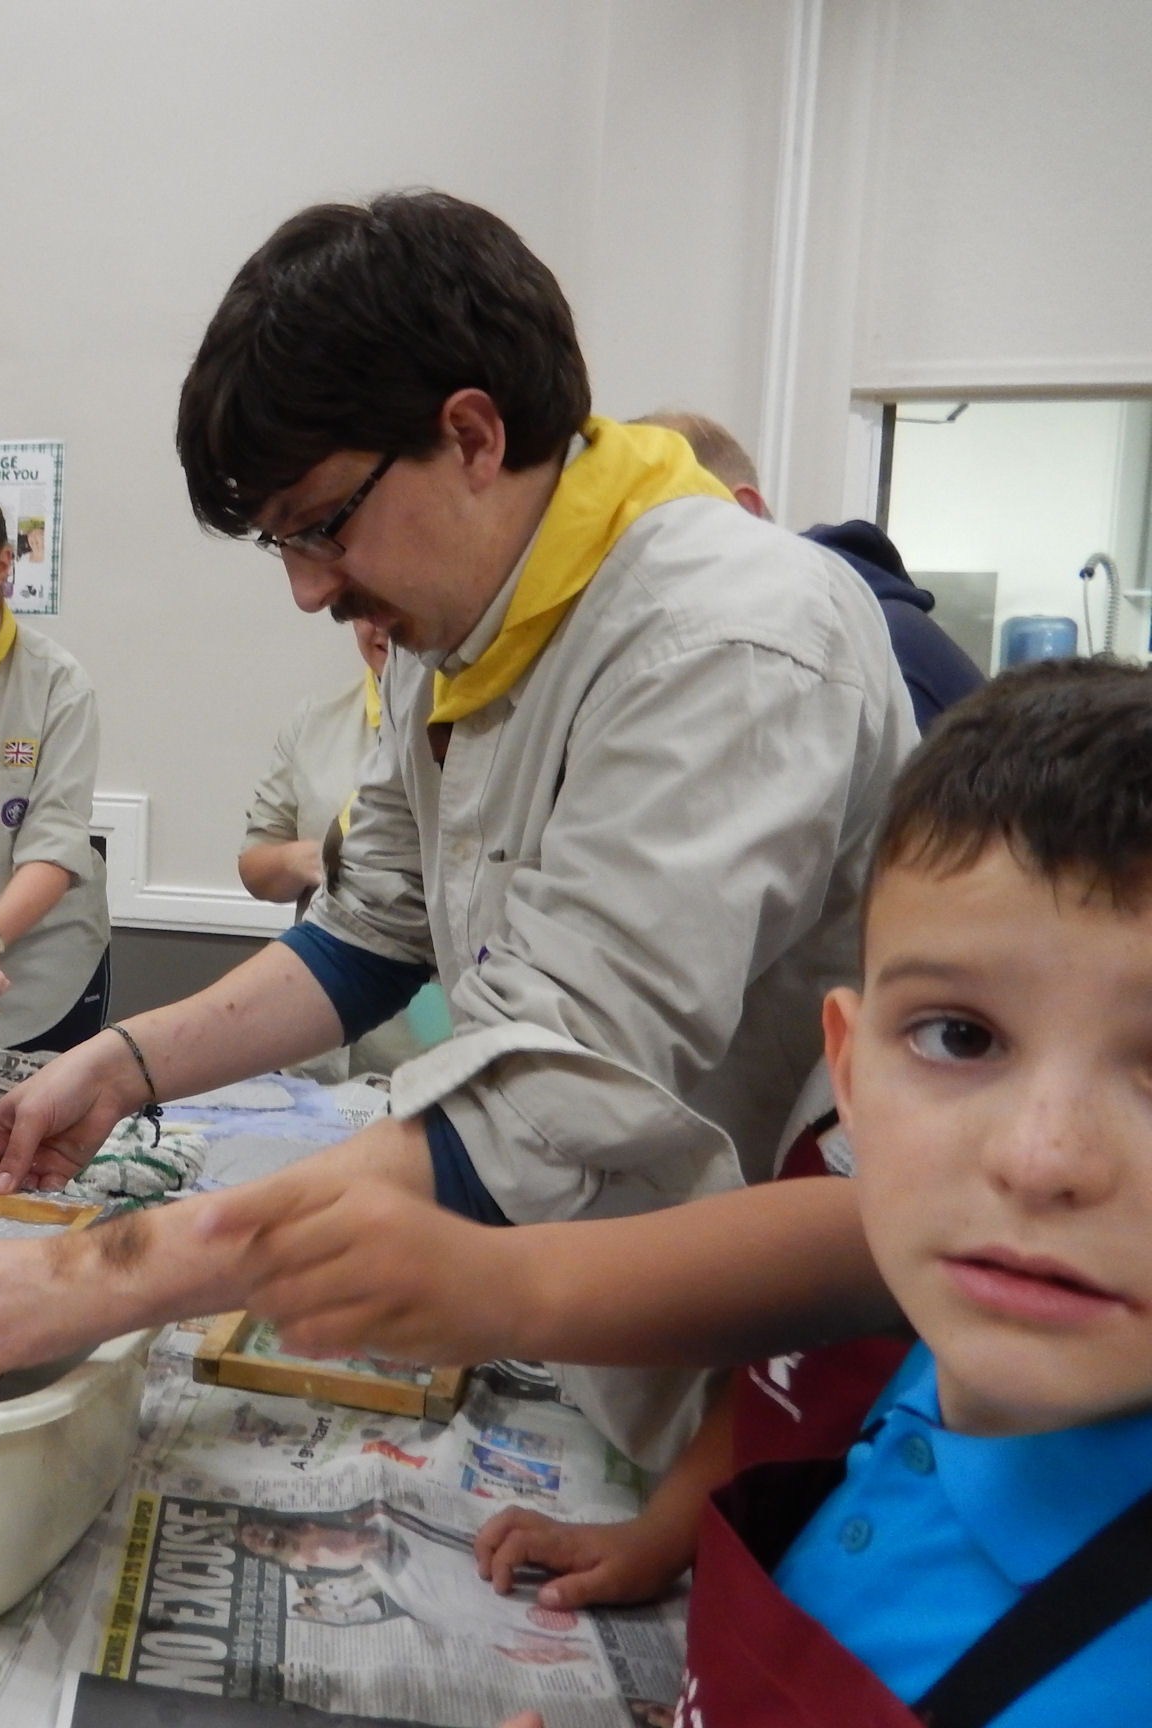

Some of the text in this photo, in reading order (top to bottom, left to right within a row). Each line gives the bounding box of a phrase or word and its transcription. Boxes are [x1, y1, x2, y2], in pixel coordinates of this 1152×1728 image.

[13, 470, 39, 481] YOU
[290, 1461, 307, 1471] A
[135, 1503, 240, 1696] NO EXCUSE
